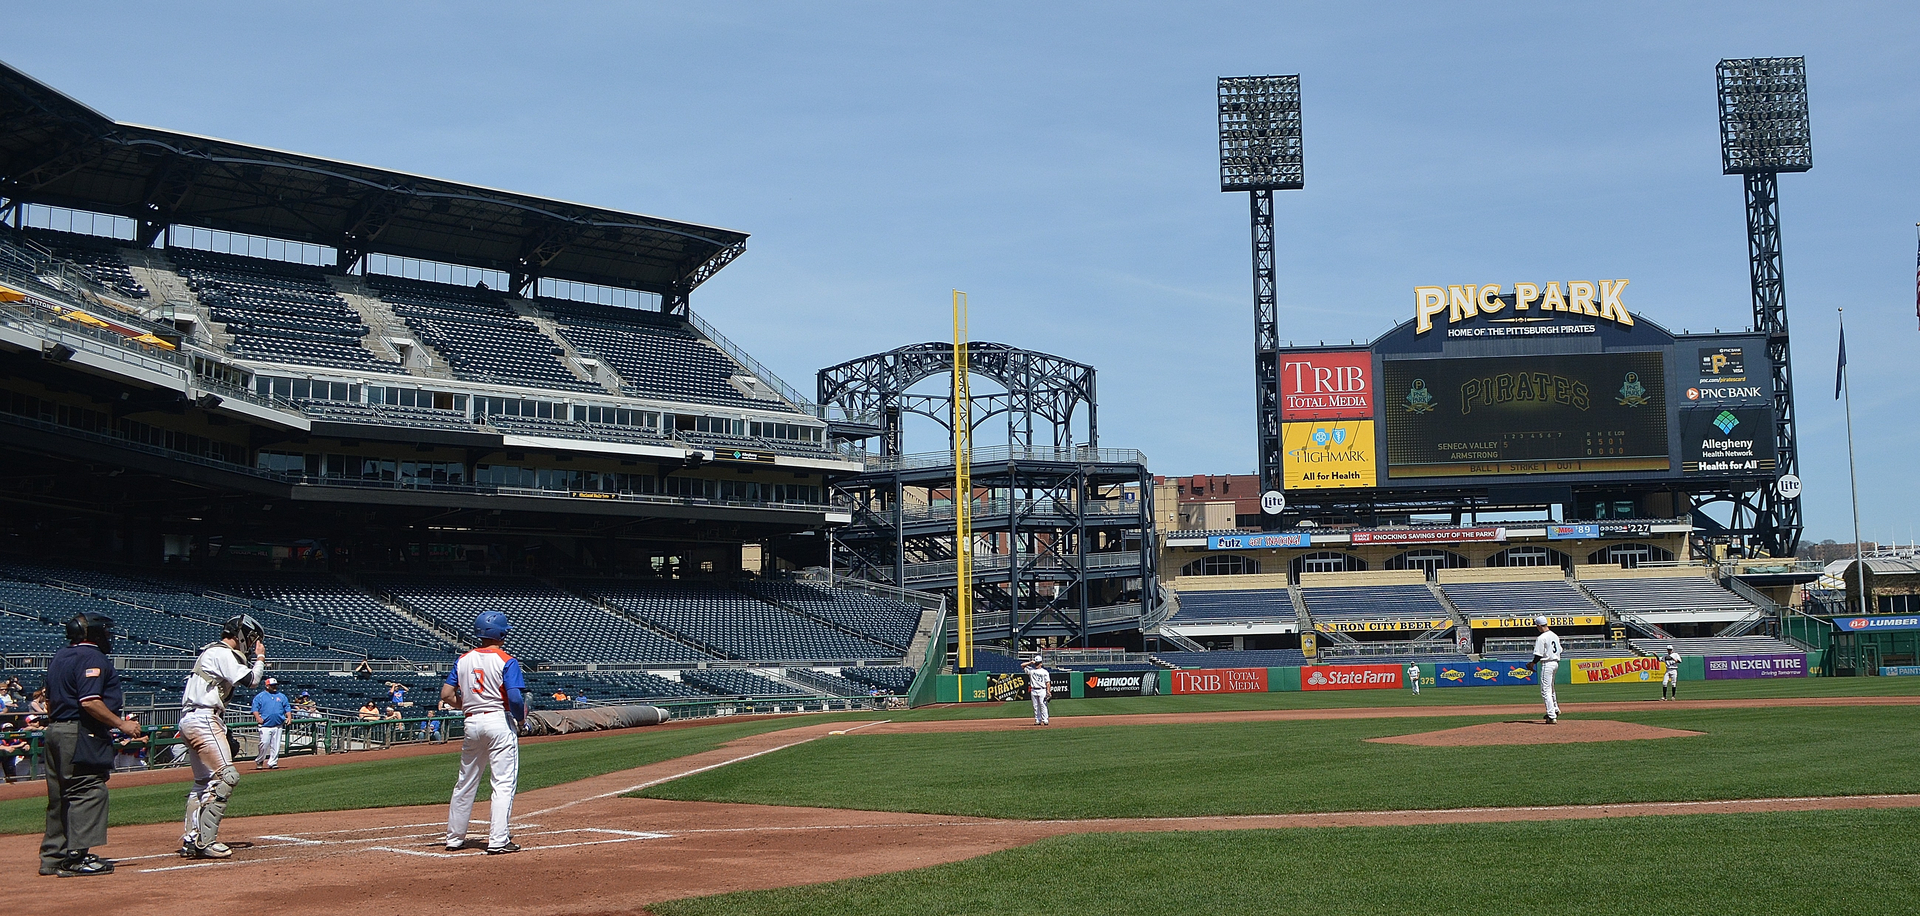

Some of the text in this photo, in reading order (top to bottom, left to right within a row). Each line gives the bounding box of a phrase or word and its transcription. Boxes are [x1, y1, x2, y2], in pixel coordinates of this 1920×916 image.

[1414, 279, 1634, 334] PNC PARK
[1448, 325, 1596, 337] HOME OF THE PITTSBURGH PIRATES
[1285, 361, 1365, 393] TRIB
[1461, 372, 1590, 415] PIRATES
[1700, 386, 1762, 399] PNC BANK
[1287, 394, 1367, 408] TOTAL MEDIA
[1438, 442, 1468, 450] SENECA
[1469, 441, 1498, 449] VALLEY
[1587, 438, 1592, 446] 5
[1702, 438, 1754, 450] Allegheny
[1296, 450, 1366, 463] HIGHMARK
[1450, 451, 1498, 460] ARMSTRONG
[1587, 448, 1592, 456] 0
[1470, 464, 1492, 472] BALL
[1510, 463, 1539, 471] STRIKE
[1556, 462, 1573, 470] OUT
[1698, 460, 1758, 470] Health for All
[1303, 470, 1360, 480] All for Health
[1780, 480, 1800, 492] Lite
[1265, 496, 1283, 508] Lite
[1627, 524, 1649, 532] $227
[1335, 621, 1432, 632] IRON CITY BEER
[1500, 619, 1510, 627] IC
[1550, 617, 1575, 626] BEER
[1869, 618, 1918, 627] LUMBER
[1551, 640, 1557, 653] 3
[1731, 658, 1801, 670] NEXEN TIRE
[471, 668, 485, 694] 3
[1176, 670, 1260, 692] TRIB TOTAL
[1229, 680, 1260, 690] MEDIA
[973, 690, 986, 698] 325
[988, 677, 1024, 700] PIRATES
